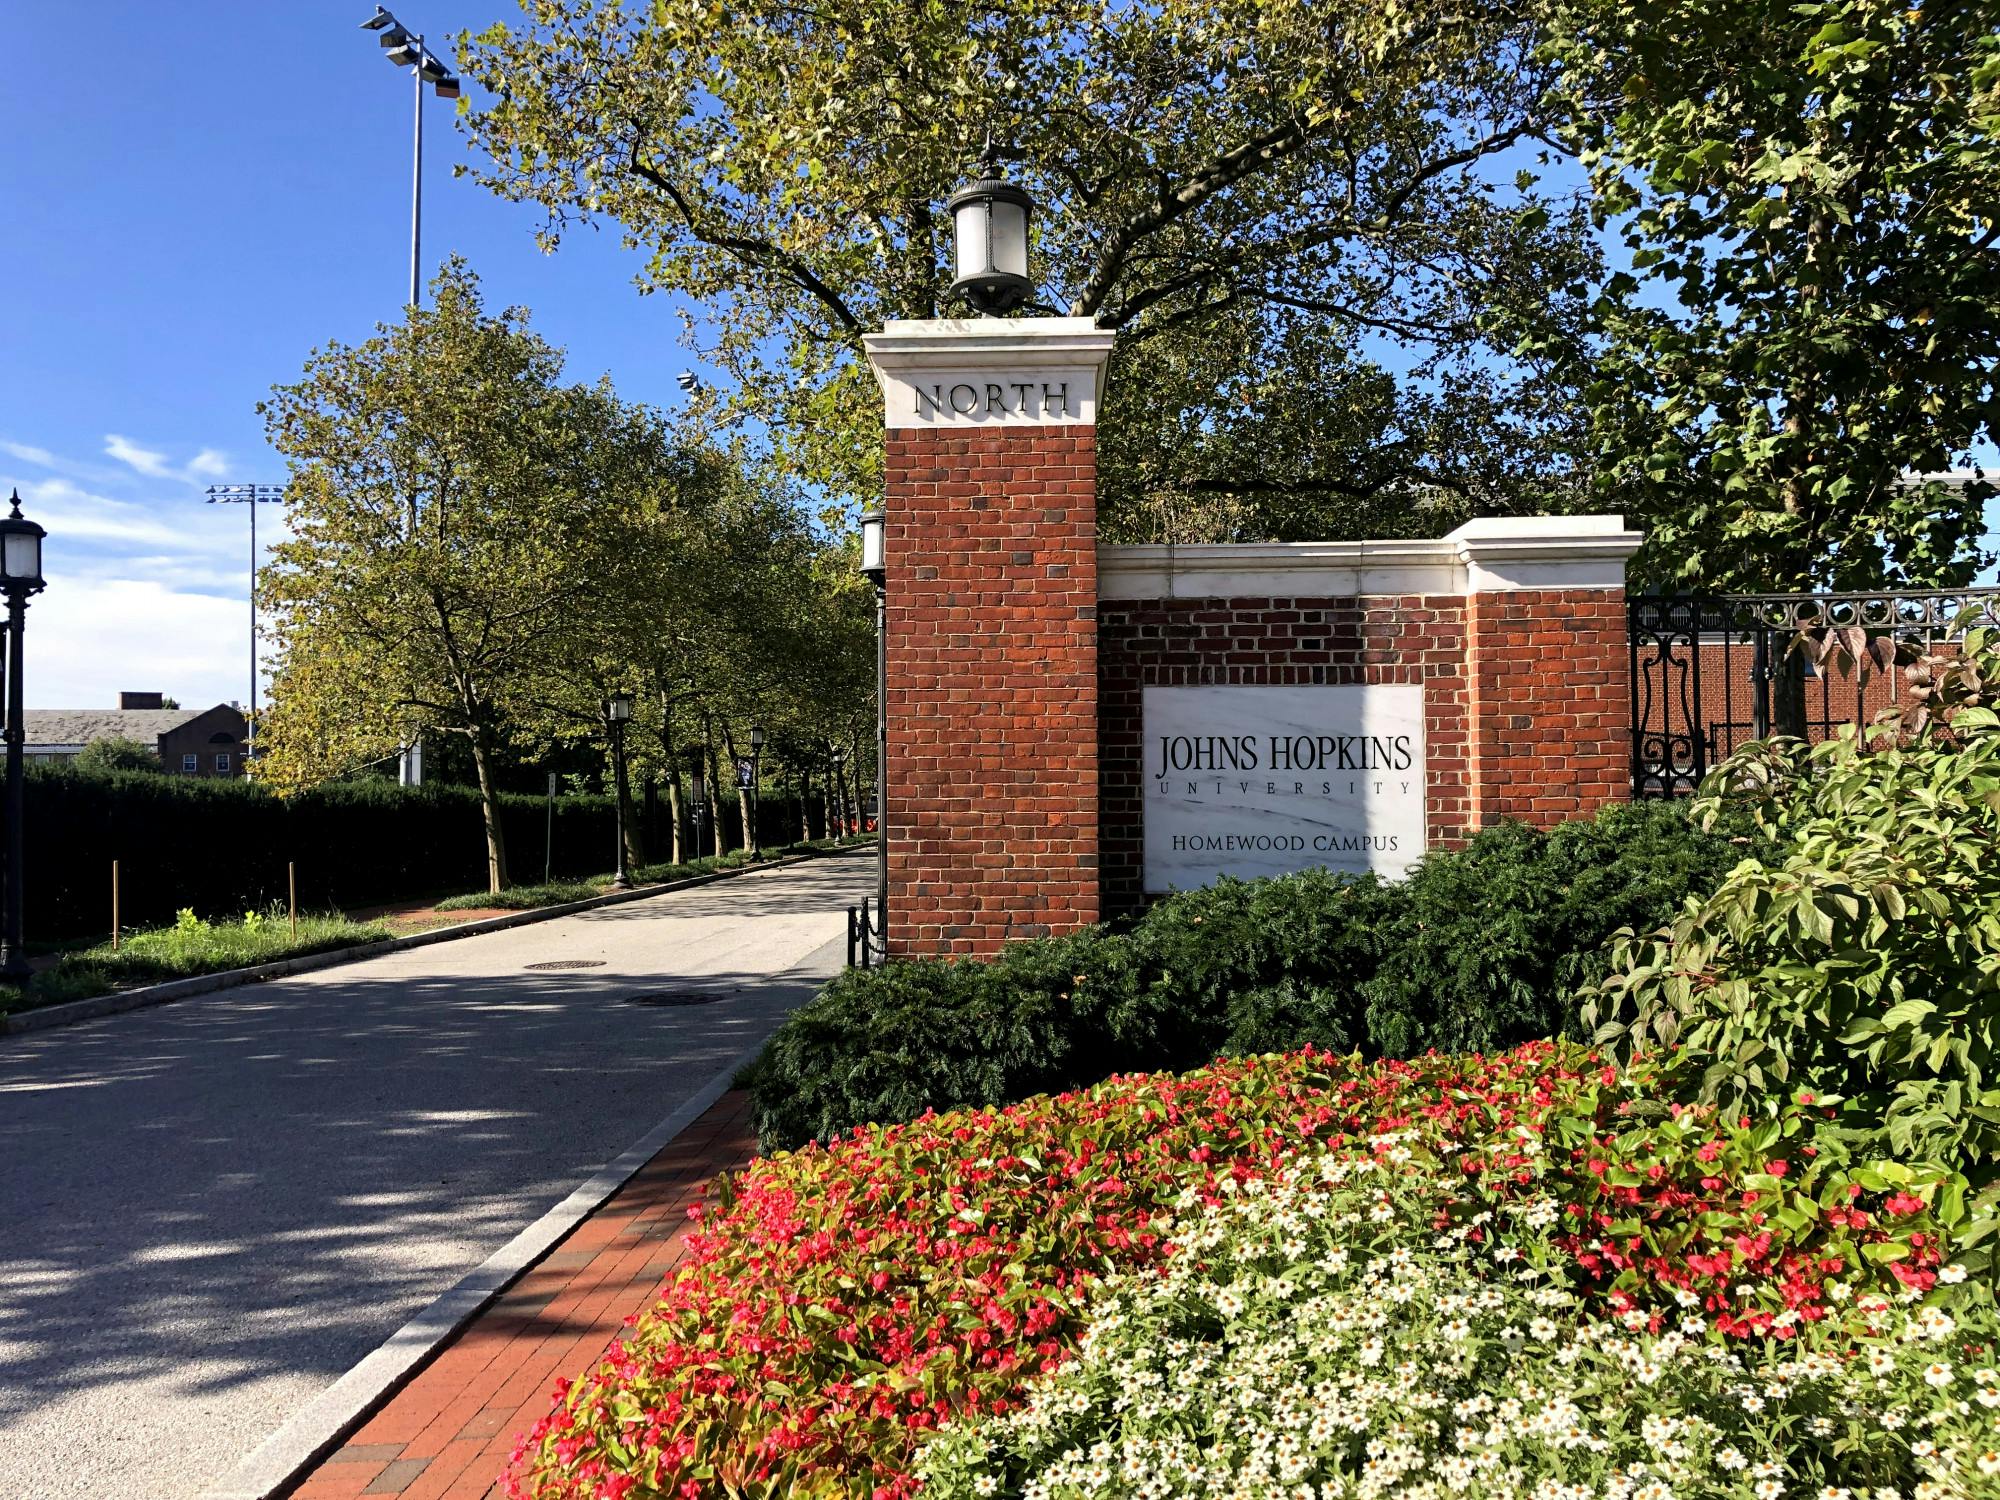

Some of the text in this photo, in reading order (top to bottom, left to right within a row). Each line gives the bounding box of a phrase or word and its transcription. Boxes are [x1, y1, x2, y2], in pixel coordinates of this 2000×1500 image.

[914, 382, 1067, 414] NORTH
[1155, 735, 1412, 779] JOHNS HOPKINS
[1160, 781, 1410, 795] UNIVERSITY
[1173, 835, 1399, 851] HOMEWOOD CAMPUS
